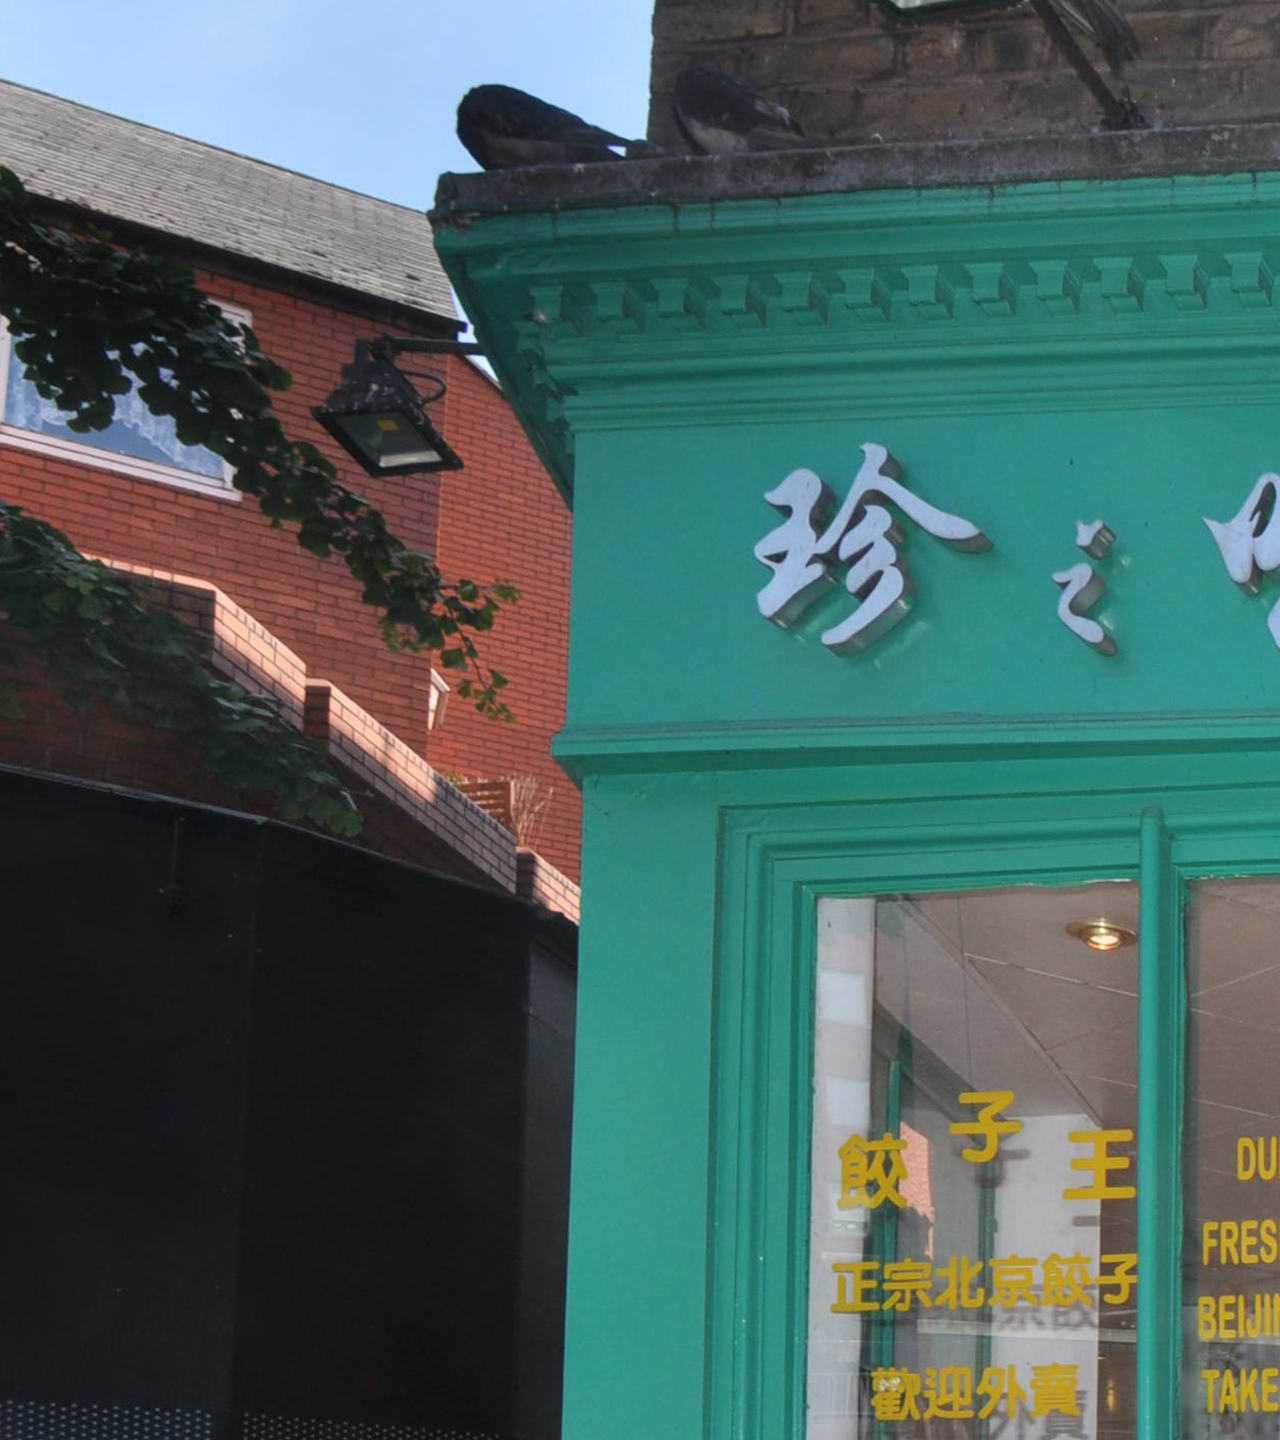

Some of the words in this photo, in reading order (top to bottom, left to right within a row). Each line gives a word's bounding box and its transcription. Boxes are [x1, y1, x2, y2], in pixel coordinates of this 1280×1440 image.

[837, 1090, 1137, 1210] 餃子王
[830, 1252, 1138, 1313] 正宗北京餃子
[871, 1362, 1082, 1421] 歡迎外賣
